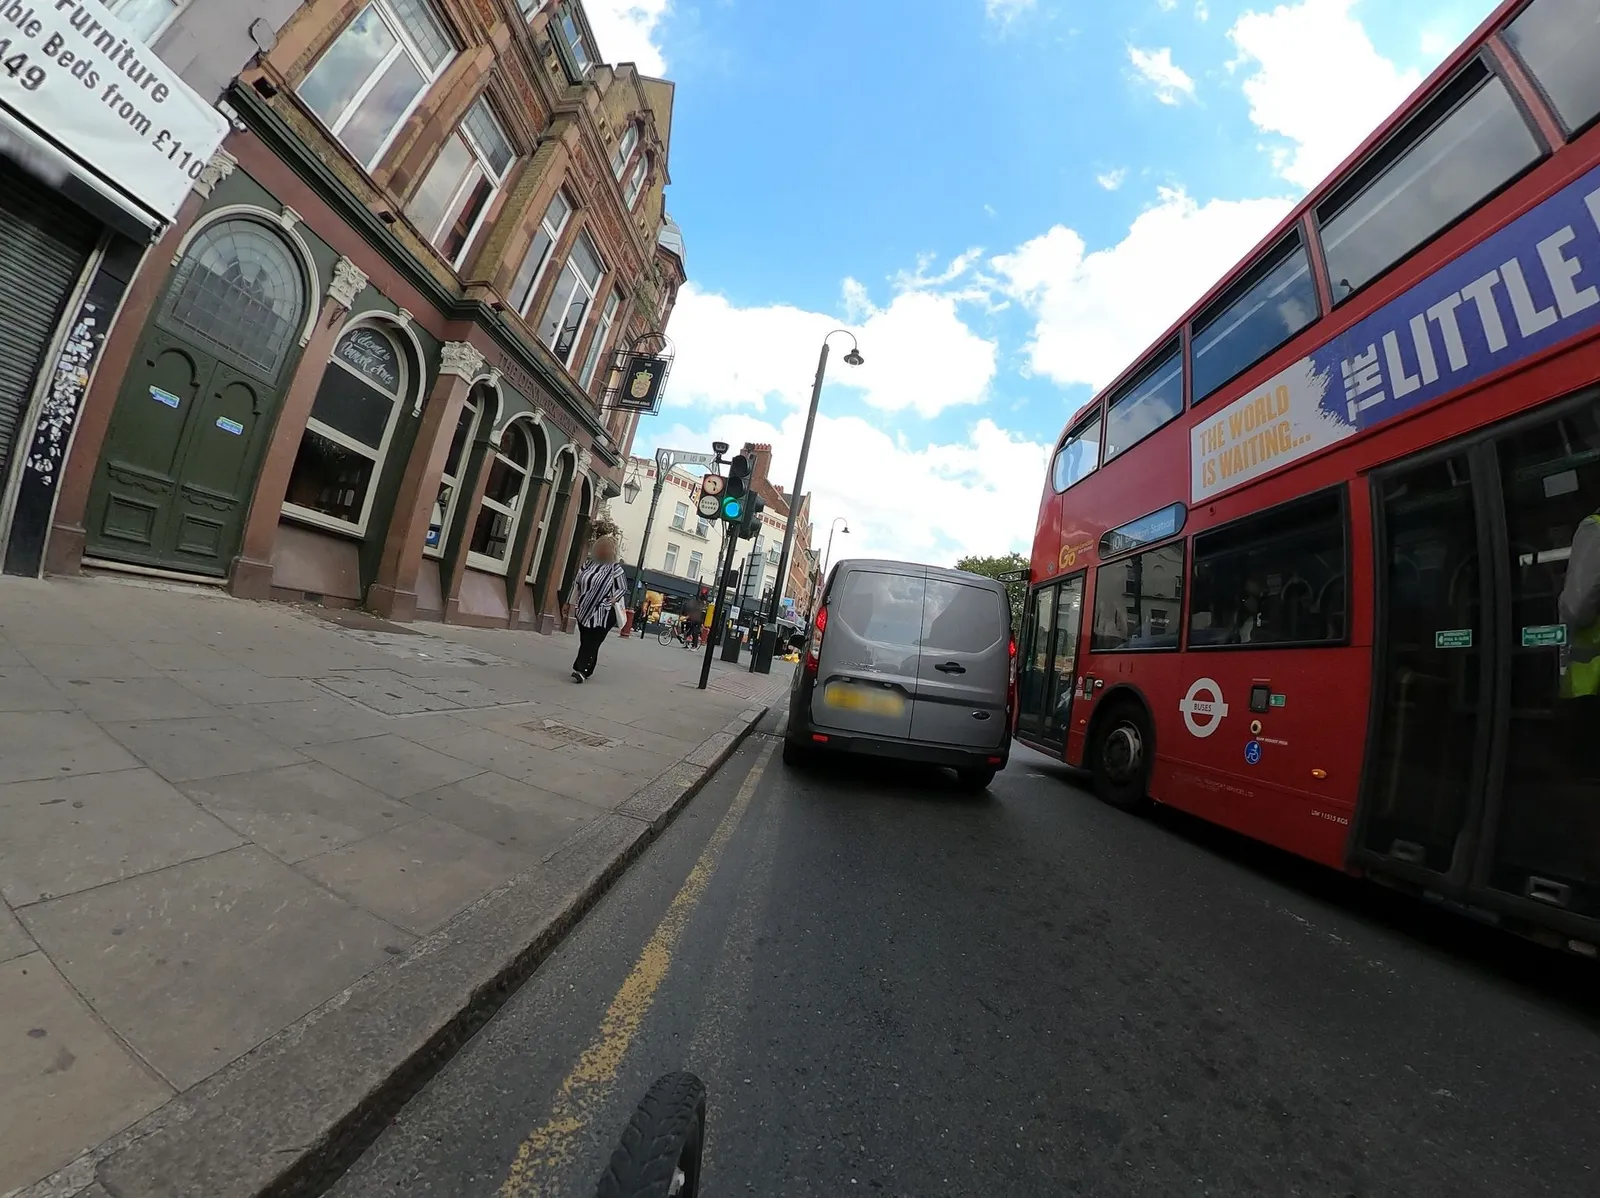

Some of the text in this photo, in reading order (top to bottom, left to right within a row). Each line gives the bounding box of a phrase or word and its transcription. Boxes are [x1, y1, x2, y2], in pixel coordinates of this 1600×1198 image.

[41, 31, 100, 89] Beds
[100, 83, 152, 136] from
[152, 129, 204, 179] £110
[1341, 225, 1600, 422] THE LITTLE
[499, 351, 518, 380] THE
[1199, 385, 1290, 456] THE WORLD
[1202, 420, 1311, 489] IS WAITING...
[1193, 702, 1213, 713] BUSES
